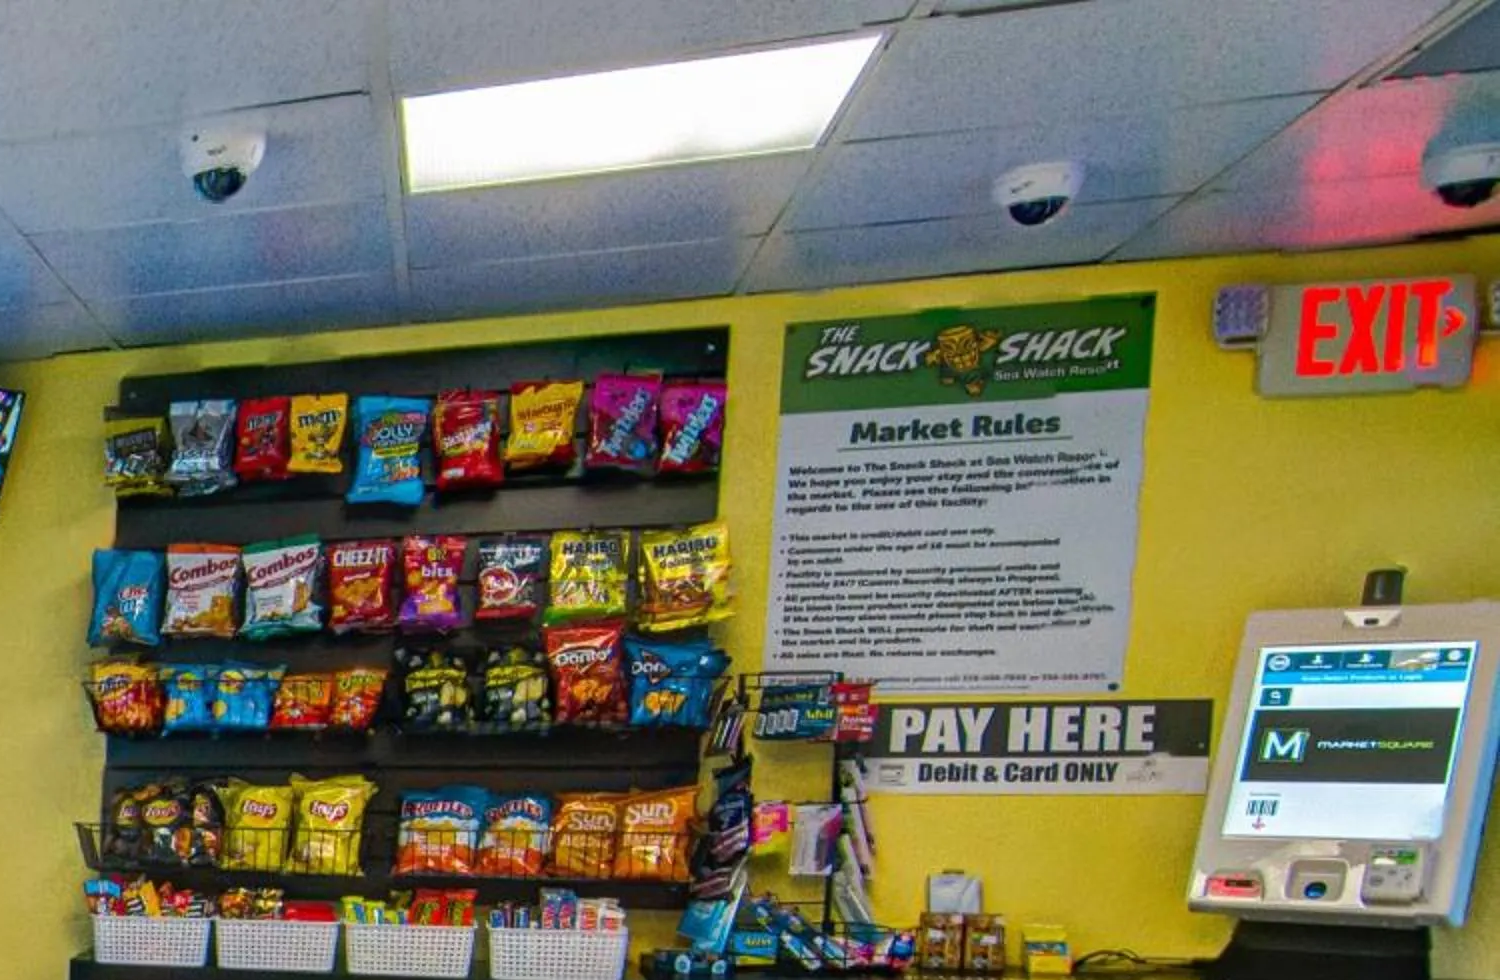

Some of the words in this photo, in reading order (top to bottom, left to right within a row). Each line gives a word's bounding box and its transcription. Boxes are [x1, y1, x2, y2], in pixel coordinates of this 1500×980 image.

[821, 325, 859, 344] THE
[1296, 279, 1452, 377] EXIT
[806, 340, 930, 378] SNACK
[997, 327, 1127, 364] SHACK
[994, 369, 1020, 381] Sea
[1023, 366, 1065, 379] Watch
[850, 418, 963, 444] Market
[971, 414, 1061, 438] Rules
[788, 480, 806, 488] We
[810, 478, 840, 488] hope
[844, 478, 866, 488] you
[870, 475, 902, 486] enjoy
[906, 476, 933, 484] your
[938, 473, 963, 484] stay
[966, 470, 990, 480] and
[993, 469, 1013, 479] the
[1105, 459, 1120, 470] of
[790, 466, 844, 475] Welcome
[848, 465, 861, 473] to
[864, 463, 886, 472] The
[890, 461, 925, 471] Snack
[930, 459, 966, 470] Shack
[970, 458, 982, 466] at
[987, 455, 1010, 466] Sea
[1014, 454, 1054, 464] Watch
[788, 493, 806, 501] the
[810, 490, 855, 500] market.
[862, 488, 900, 498] Please
[905, 487, 924, 496] see
[928, 486, 948, 495] the
[952, 484, 1012, 493] following
[786, 505, 832, 516] regards
[836, 503, 848, 512] to
[852, 502, 871, 511] the
[875, 502, 895, 511] use
[898, 500, 912, 509] of
[915, 499, 937, 508] this
[171, 558, 238, 584] Combos
[247, 547, 315, 580] Combos
[889, 706, 996, 753] PAY
[1007, 705, 1156, 752] HERE
[918, 761, 977, 782] Debit
[983, 764, 999, 783] &
[1004, 761, 1058, 783] Card
[1064, 761, 1119, 783] ONLY
